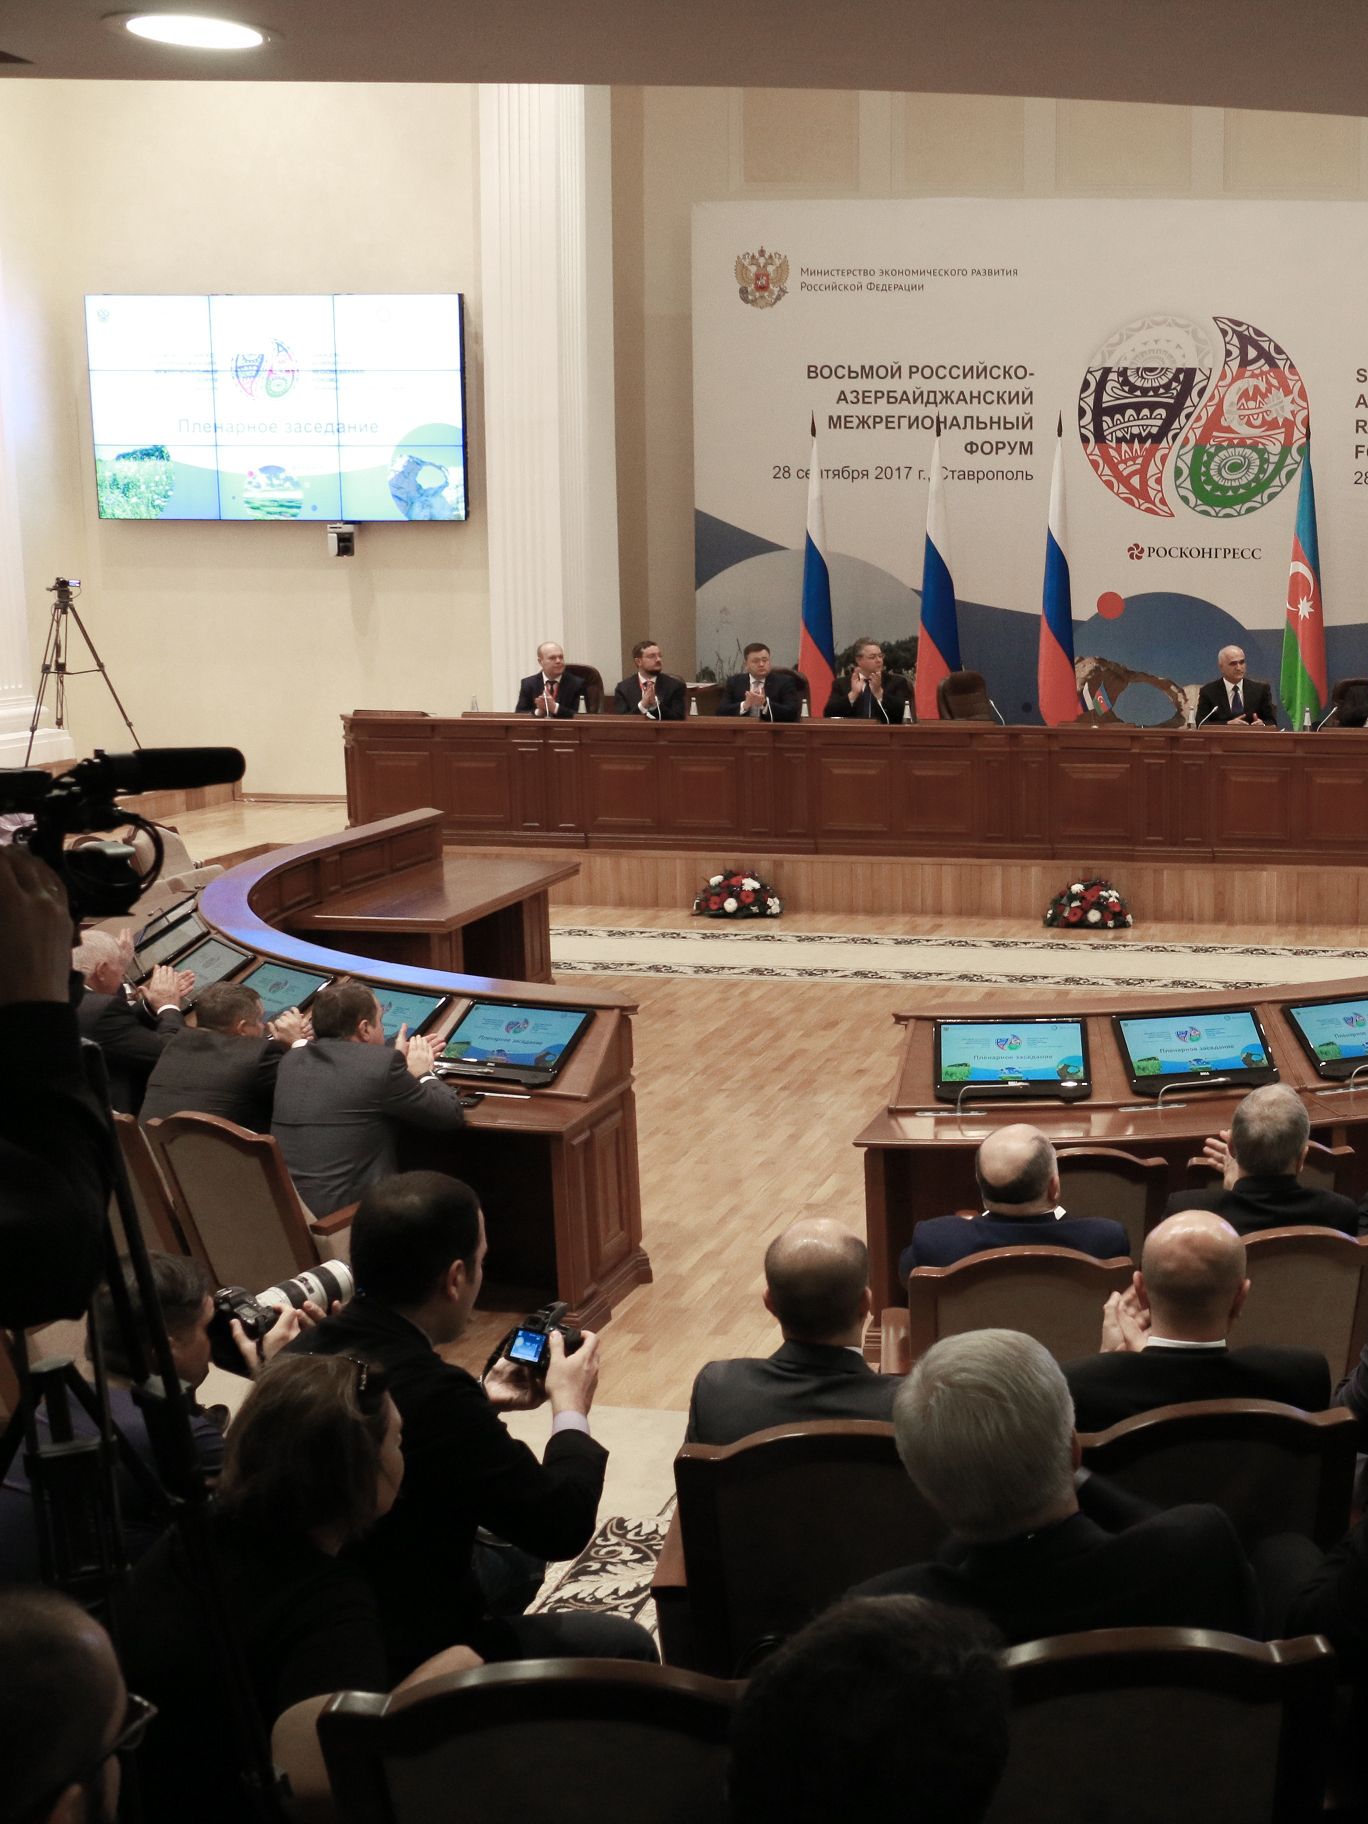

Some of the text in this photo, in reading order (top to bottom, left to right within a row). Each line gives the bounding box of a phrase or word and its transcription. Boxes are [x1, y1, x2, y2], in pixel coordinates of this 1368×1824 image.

[806, 360, 1035, 380] ВОСЬМОЙ РОССИЙСКО-
[836, 386, 1034, 408] АЗЕРБАЙДЖАНСКИЙ
[178, 418, 279, 437] Пленарное
[827, 411, 1034, 431] МЕЖРЕГИОНАЛЬНЫЙ
[963, 440, 1034, 456] ФОРУМ
[772, 465, 792, 480] 28
[796, 465, 870, 484] сетября
[874, 465, 913, 481] 2017
[1146, 546, 1262, 560] РОСКОНГРЕСС
